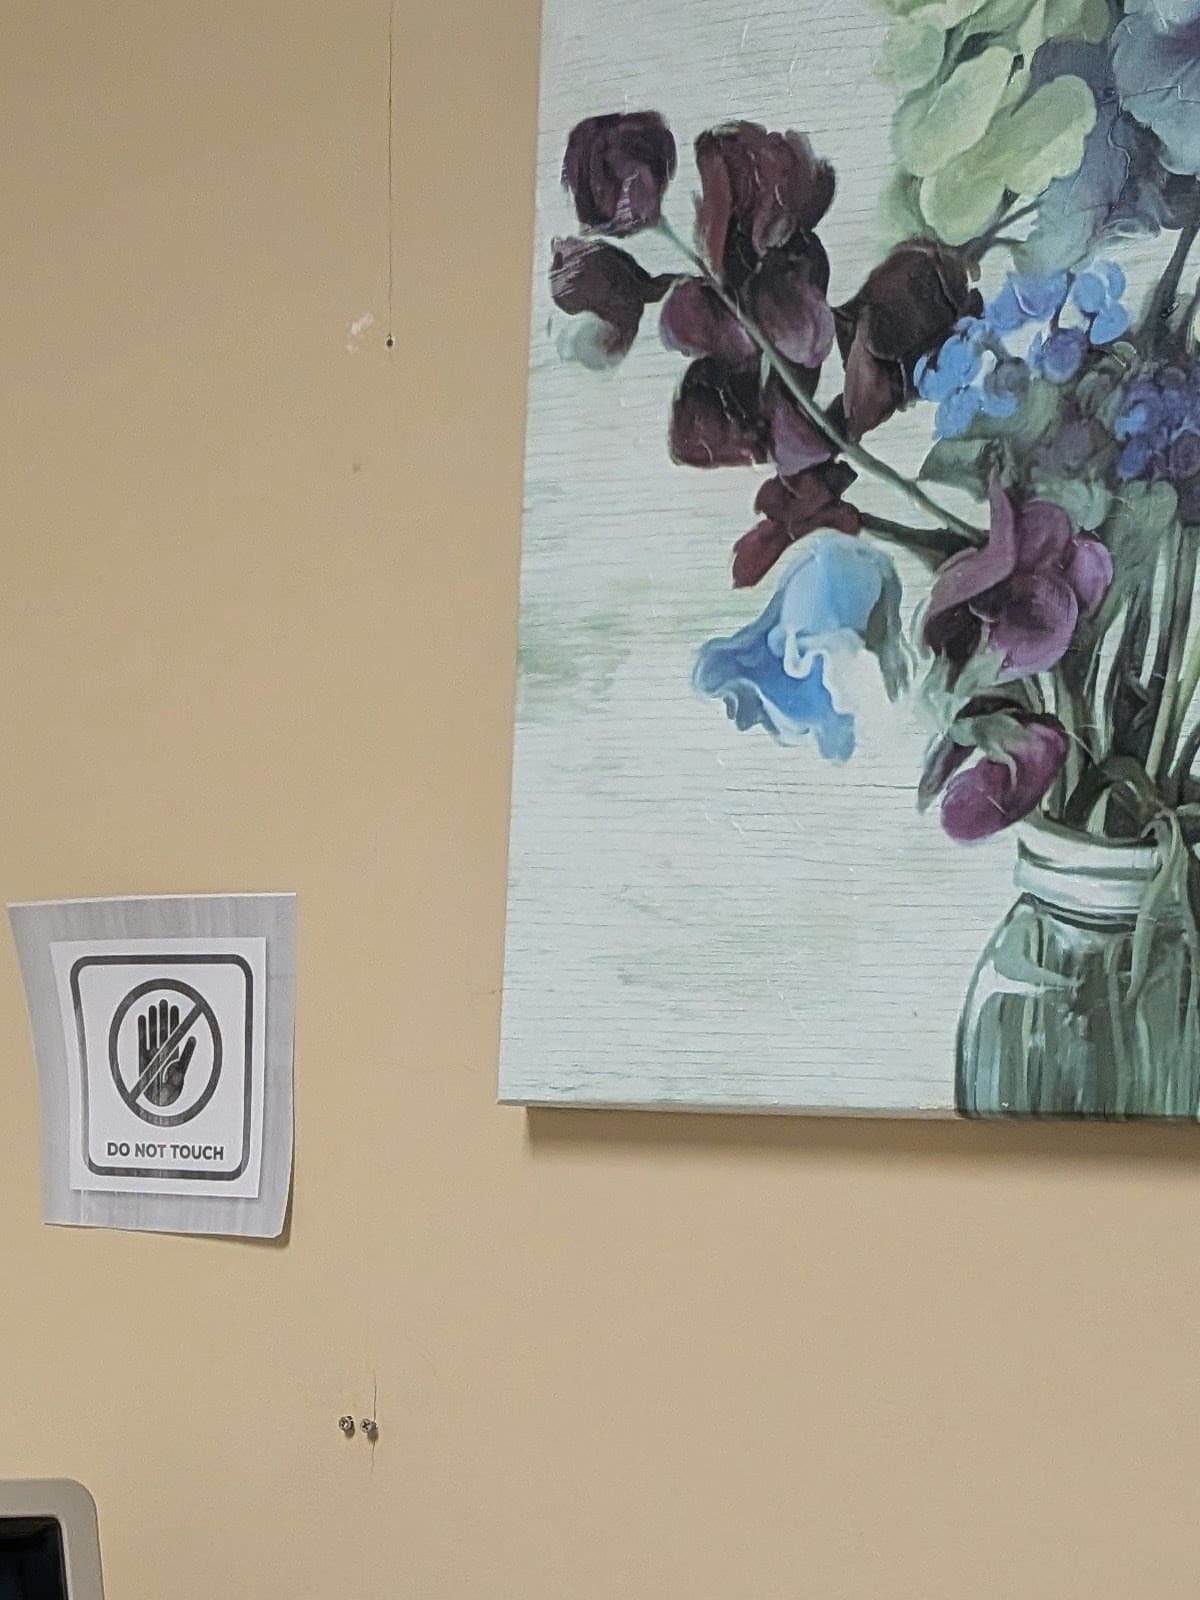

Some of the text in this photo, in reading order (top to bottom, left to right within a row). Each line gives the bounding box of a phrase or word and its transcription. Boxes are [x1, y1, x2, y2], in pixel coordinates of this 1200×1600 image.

[107, 1142, 224, 1160] DO NOT TOUCH
